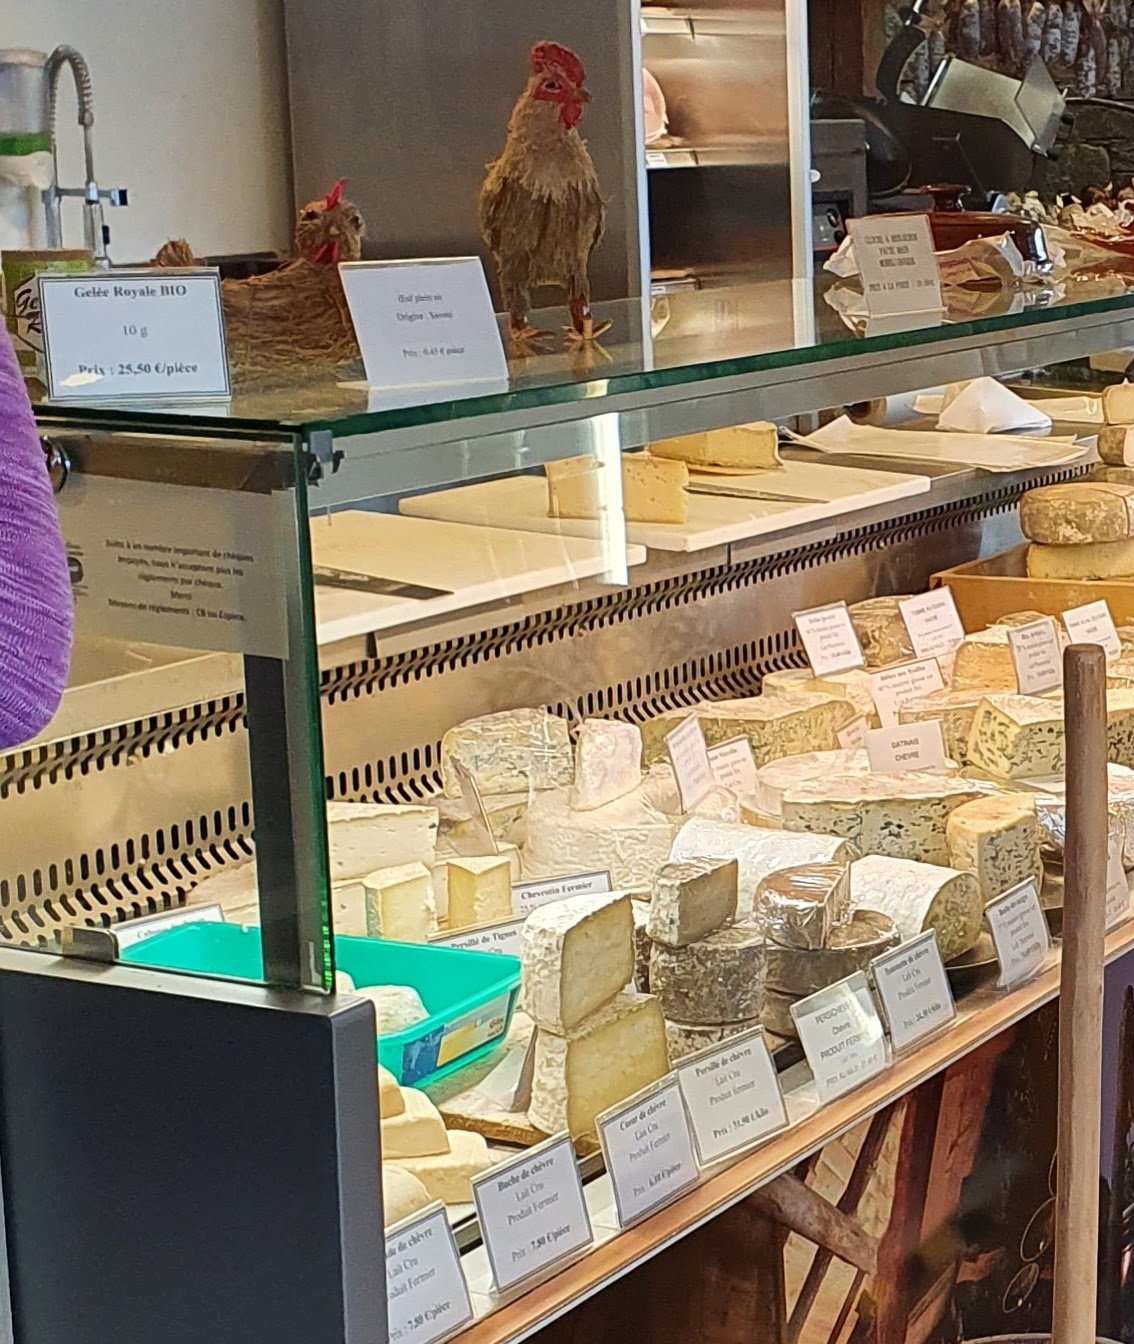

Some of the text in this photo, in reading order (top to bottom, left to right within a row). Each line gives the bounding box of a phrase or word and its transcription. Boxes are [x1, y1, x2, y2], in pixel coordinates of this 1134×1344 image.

[113, 286, 156, 300] Royale
[160, 285, 187, 296] BIO
[122, 325, 148, 339] 10 g
[78, 364, 106, 376] Prix
[389, 1280, 409, 1300] oduit
[390, 1327, 404, 1341] rix
